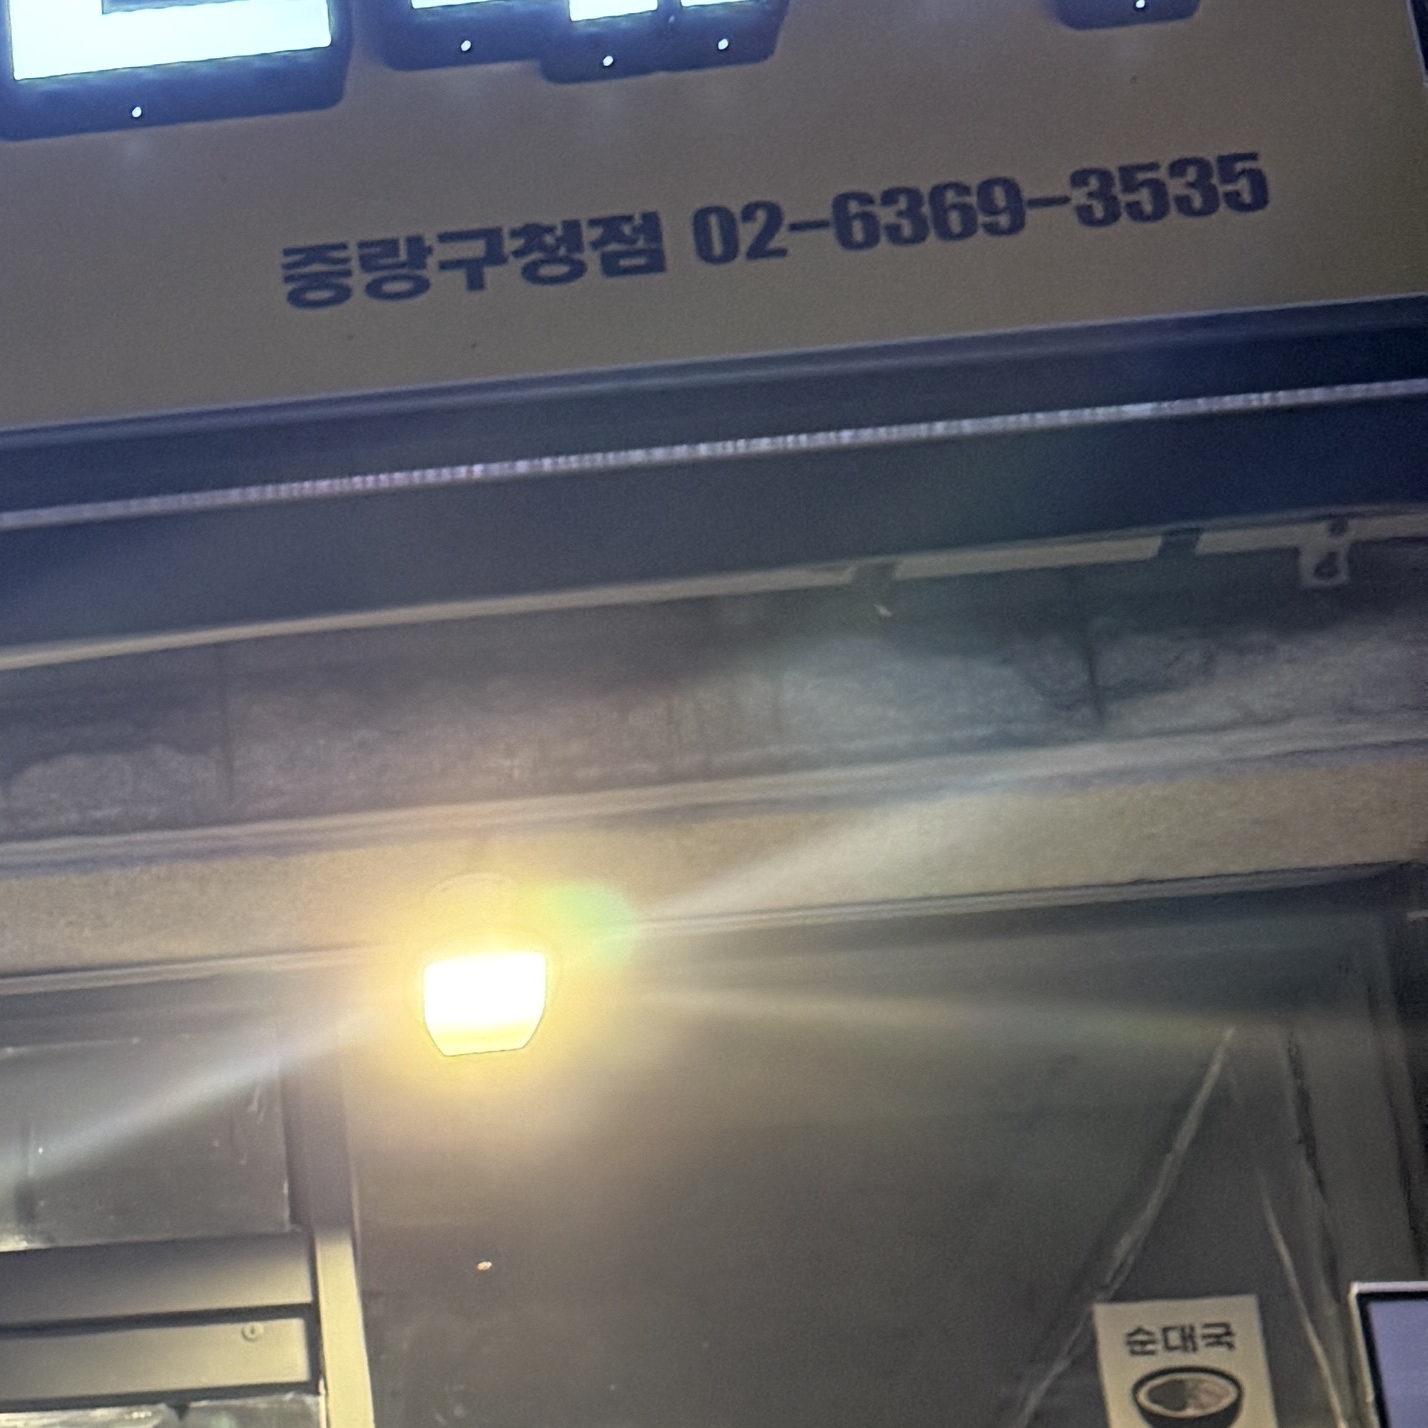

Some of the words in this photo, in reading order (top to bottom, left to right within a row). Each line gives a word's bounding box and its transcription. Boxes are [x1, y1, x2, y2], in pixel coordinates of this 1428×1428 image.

[280, 210, 668, 310] 중랑구청점
[692, 151, 1271, 266] 02-6369-3535
[1125, 1322, 1237, 1357] 순대국
